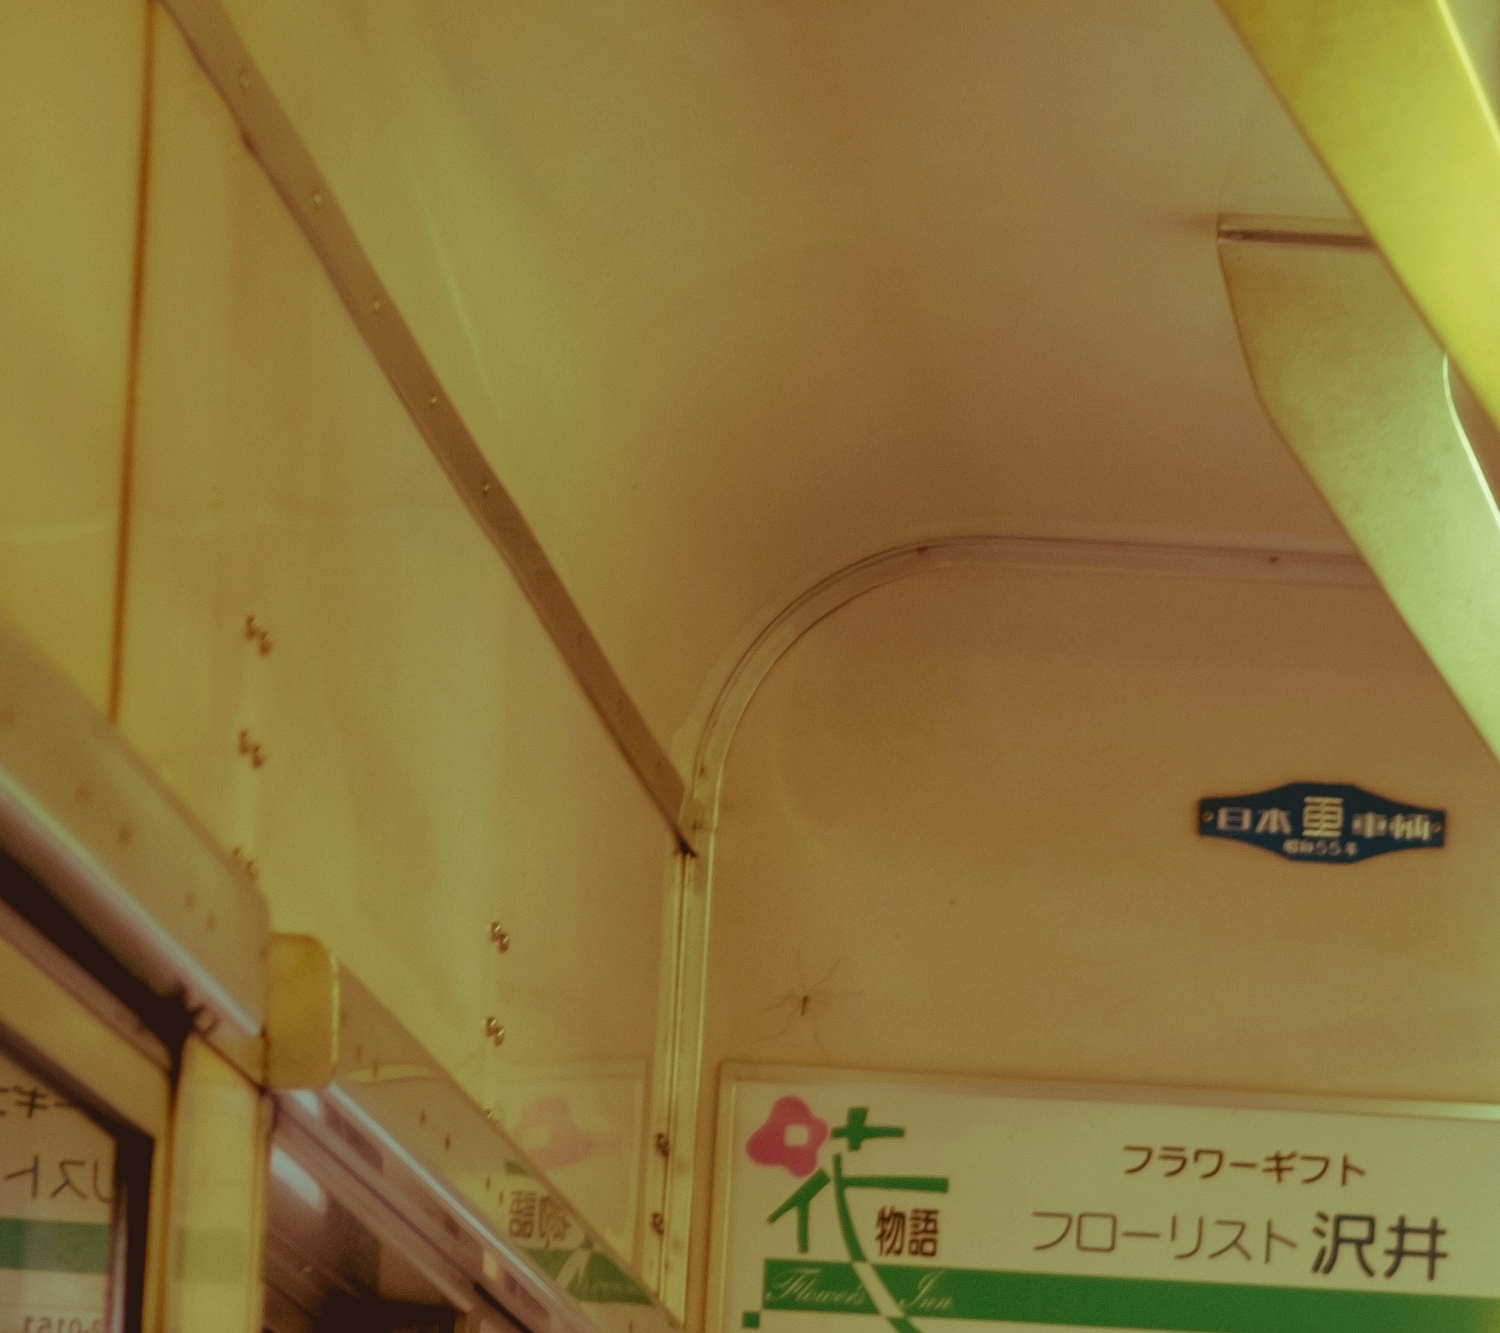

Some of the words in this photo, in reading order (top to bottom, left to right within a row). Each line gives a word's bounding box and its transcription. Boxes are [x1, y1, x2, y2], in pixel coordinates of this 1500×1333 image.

[1123, 1144, 1366, 1187] フラワーギフト
[1032, 1210, 1298, 1264] フローリスト
[1311, 1210, 1449, 1281] 沢井
